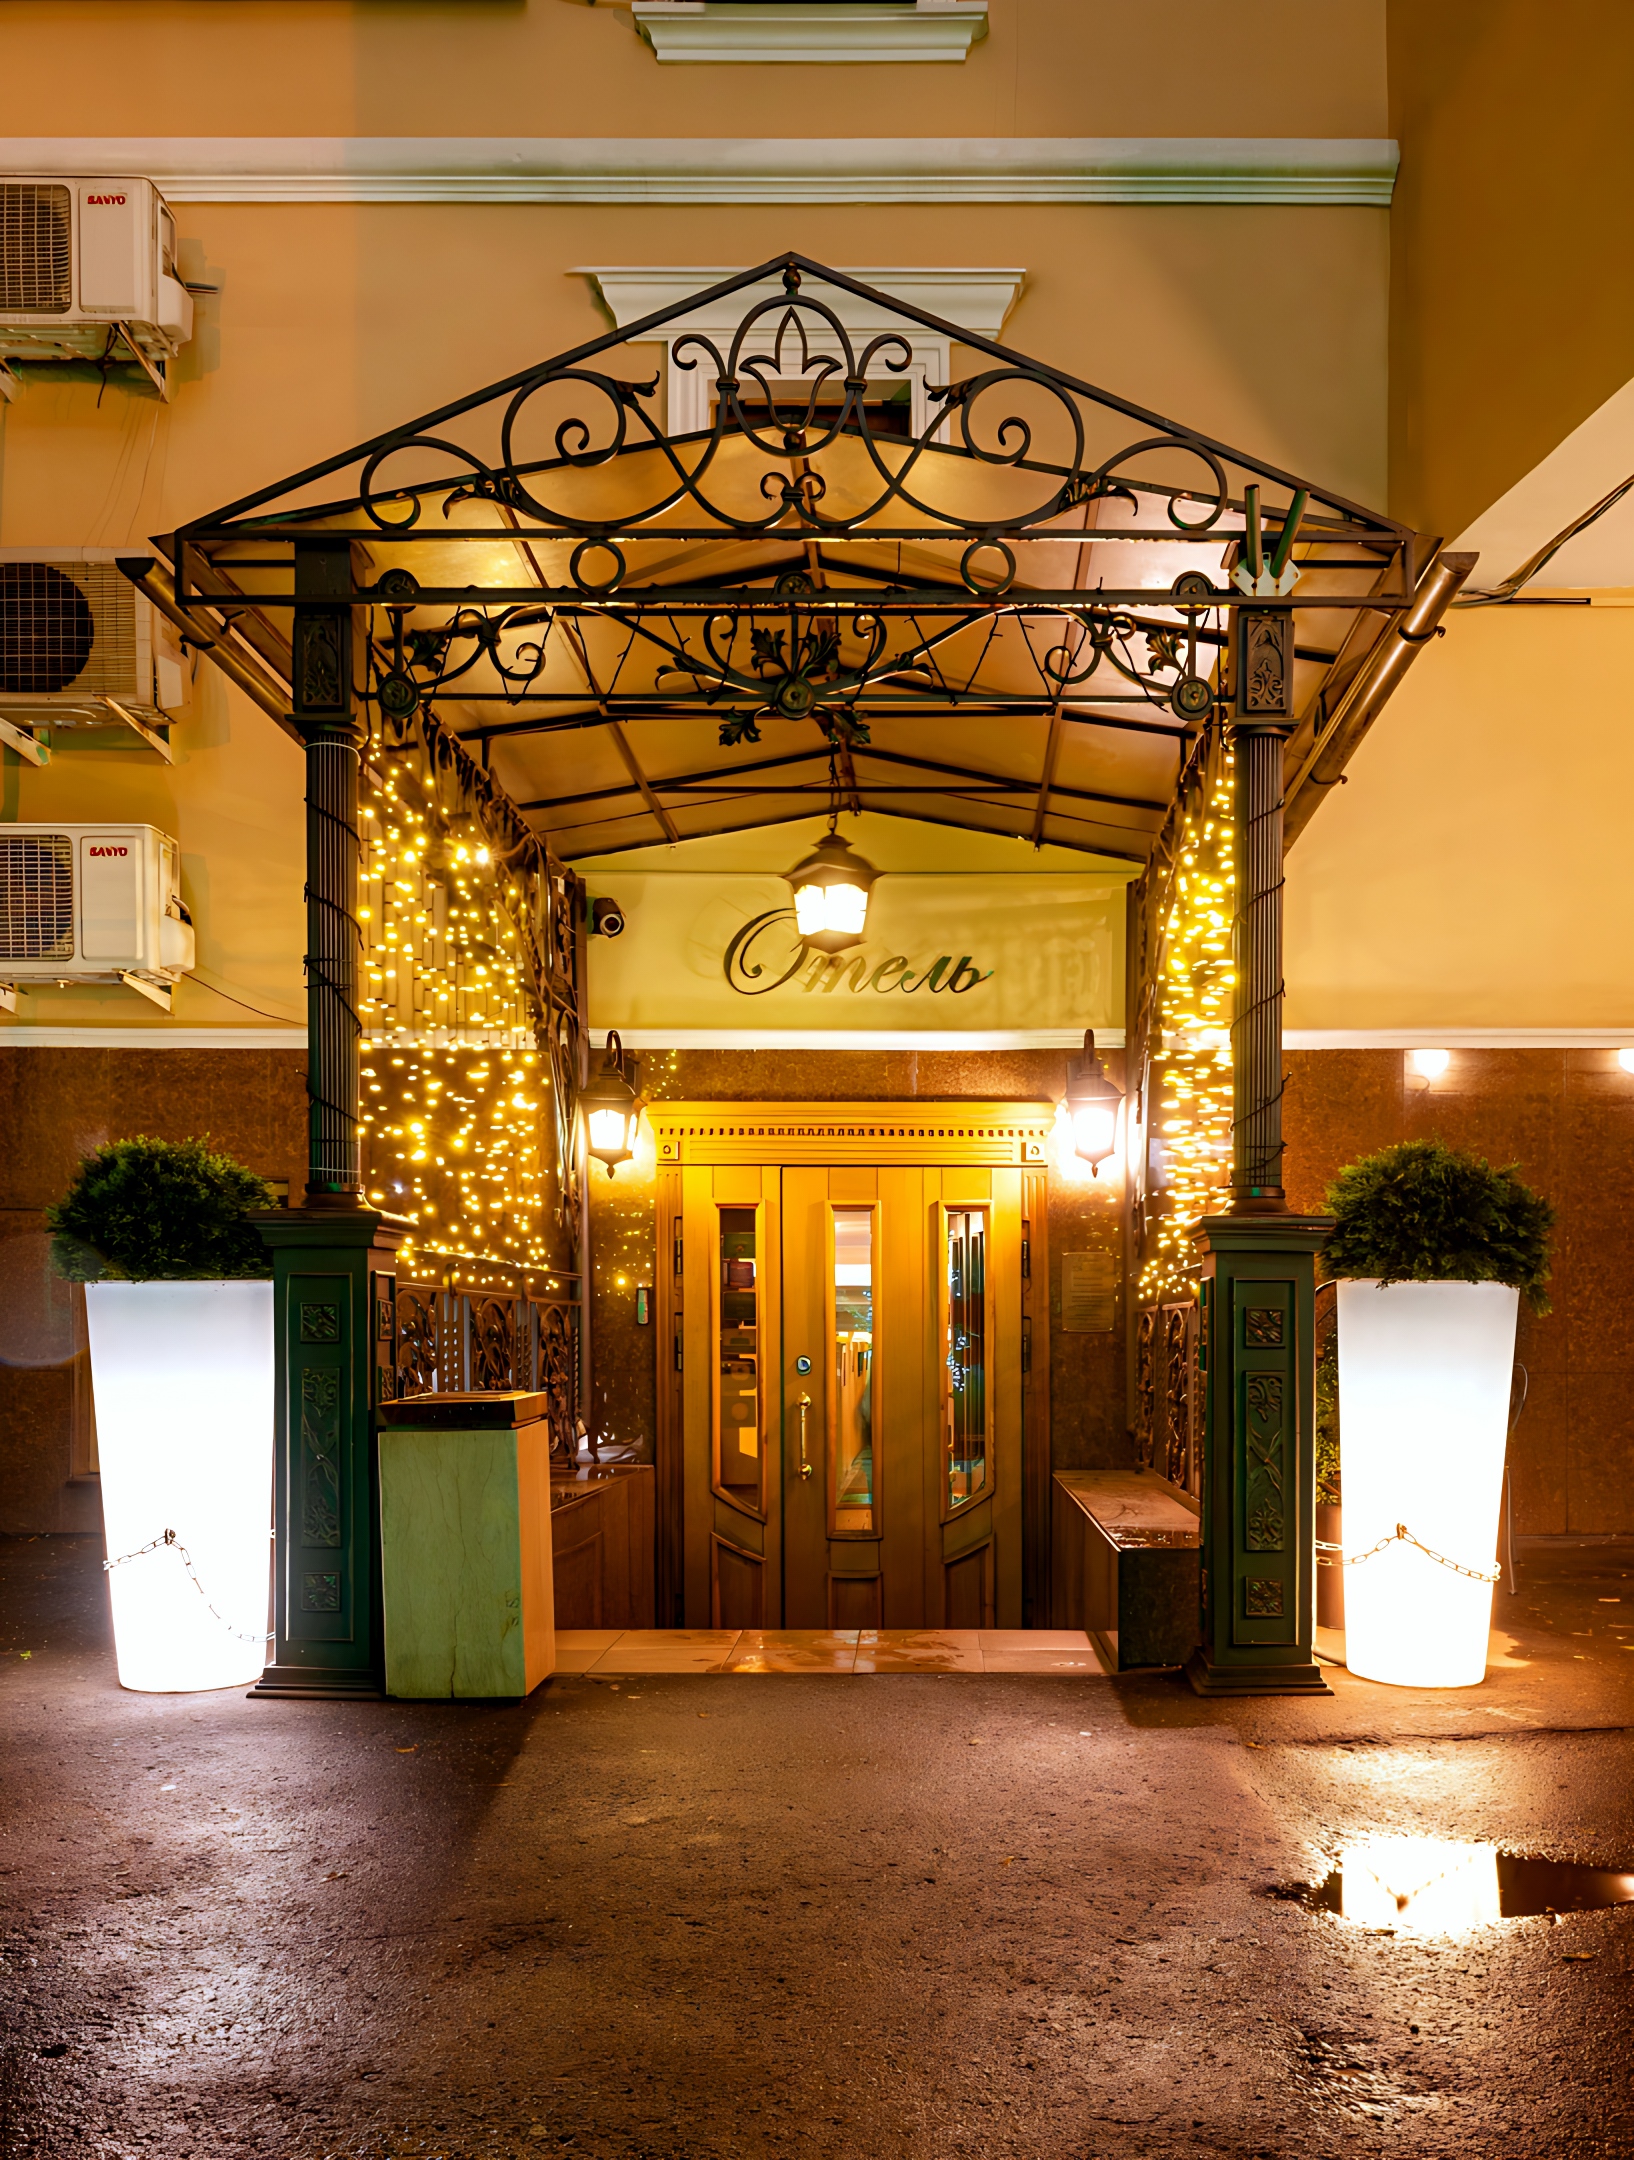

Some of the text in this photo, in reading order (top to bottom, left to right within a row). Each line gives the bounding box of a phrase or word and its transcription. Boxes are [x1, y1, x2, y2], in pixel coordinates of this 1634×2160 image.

[87, 195, 126, 206] SANYO
[89, 846, 128, 857] SANYO
[723, 907, 995, 996] Отель
